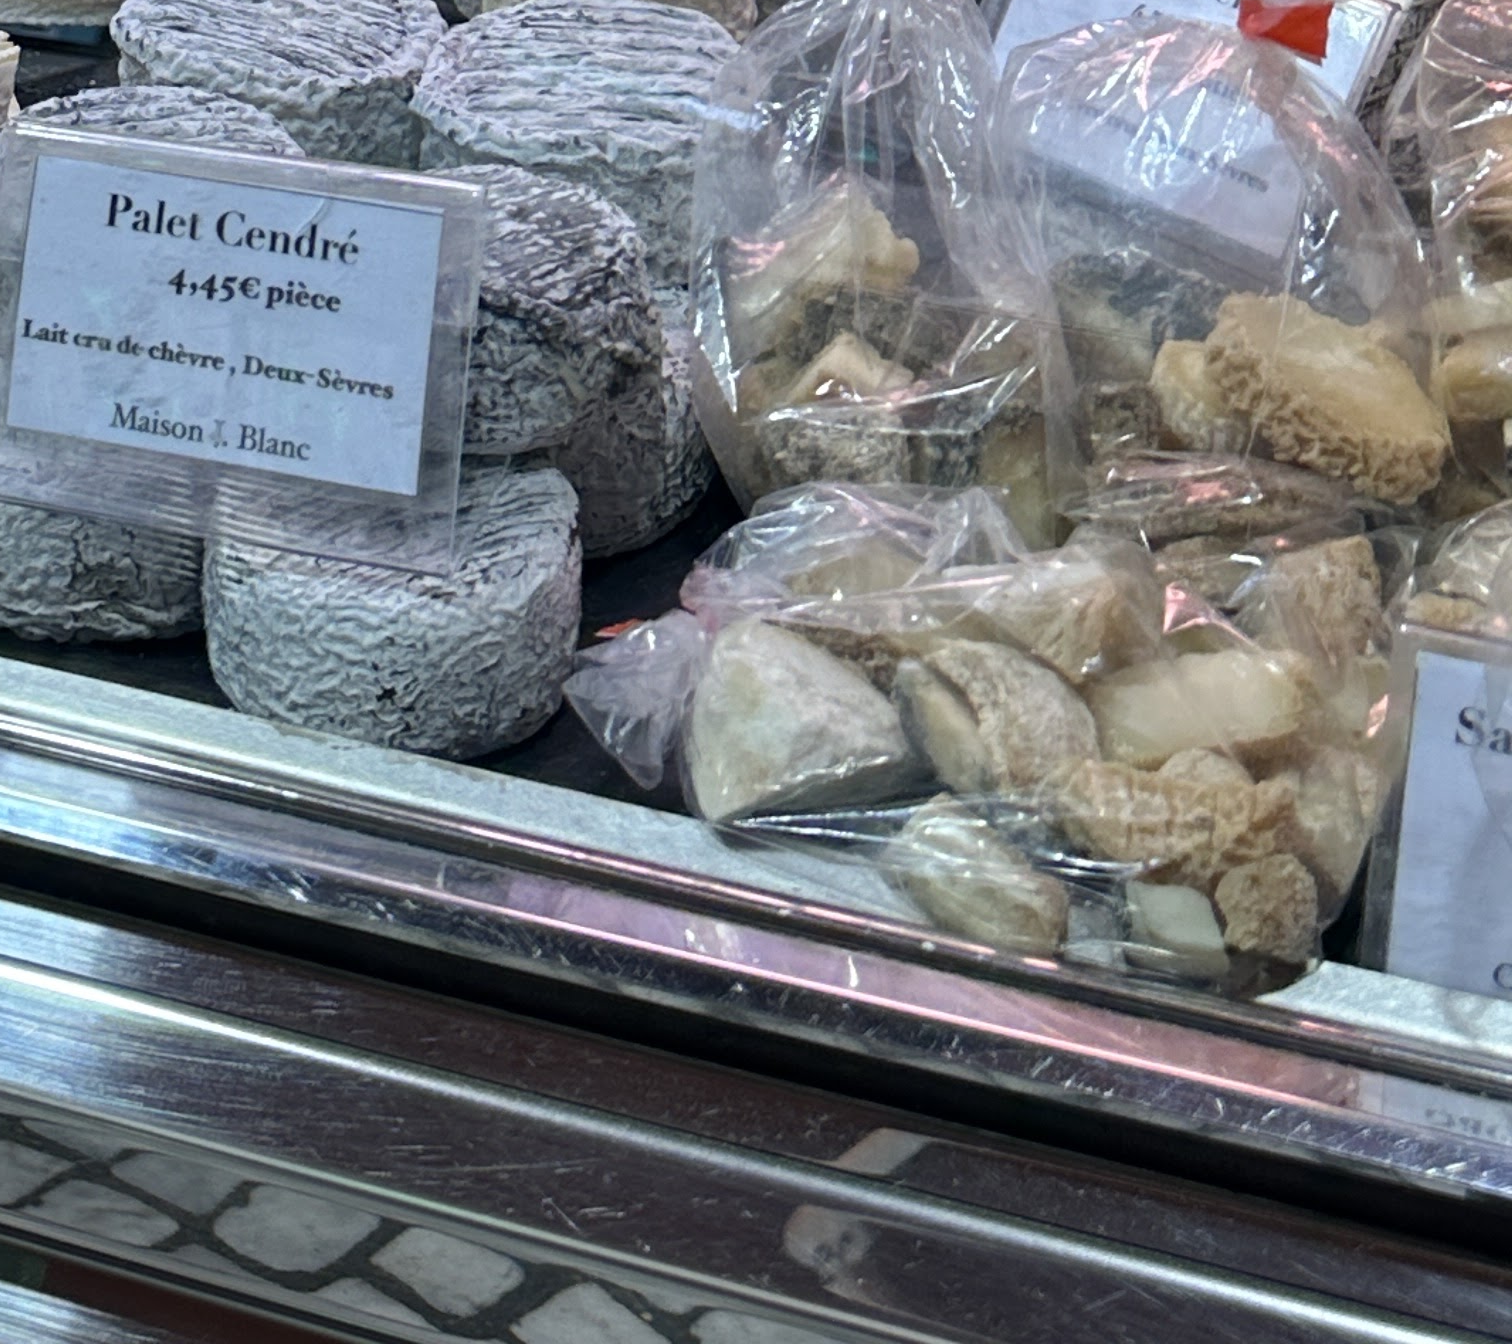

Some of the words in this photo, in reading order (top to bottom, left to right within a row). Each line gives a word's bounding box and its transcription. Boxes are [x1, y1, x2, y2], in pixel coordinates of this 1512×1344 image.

[105, 192, 201, 241] Palet
[215, 210, 361, 265] Cendré
[167, 268, 261, 303] 4,45€
[265, 281, 343, 313] pièce
[22, 318, 69, 346] Lait
[72, 332, 113, 353] cru
[116, 331, 145, 357] de
[147, 336, 226, 372] chèvre
[241, 353, 396, 400] Deux-Sèvres
[110, 402, 204, 443] Maison
[238, 423, 313, 461] Blanc
